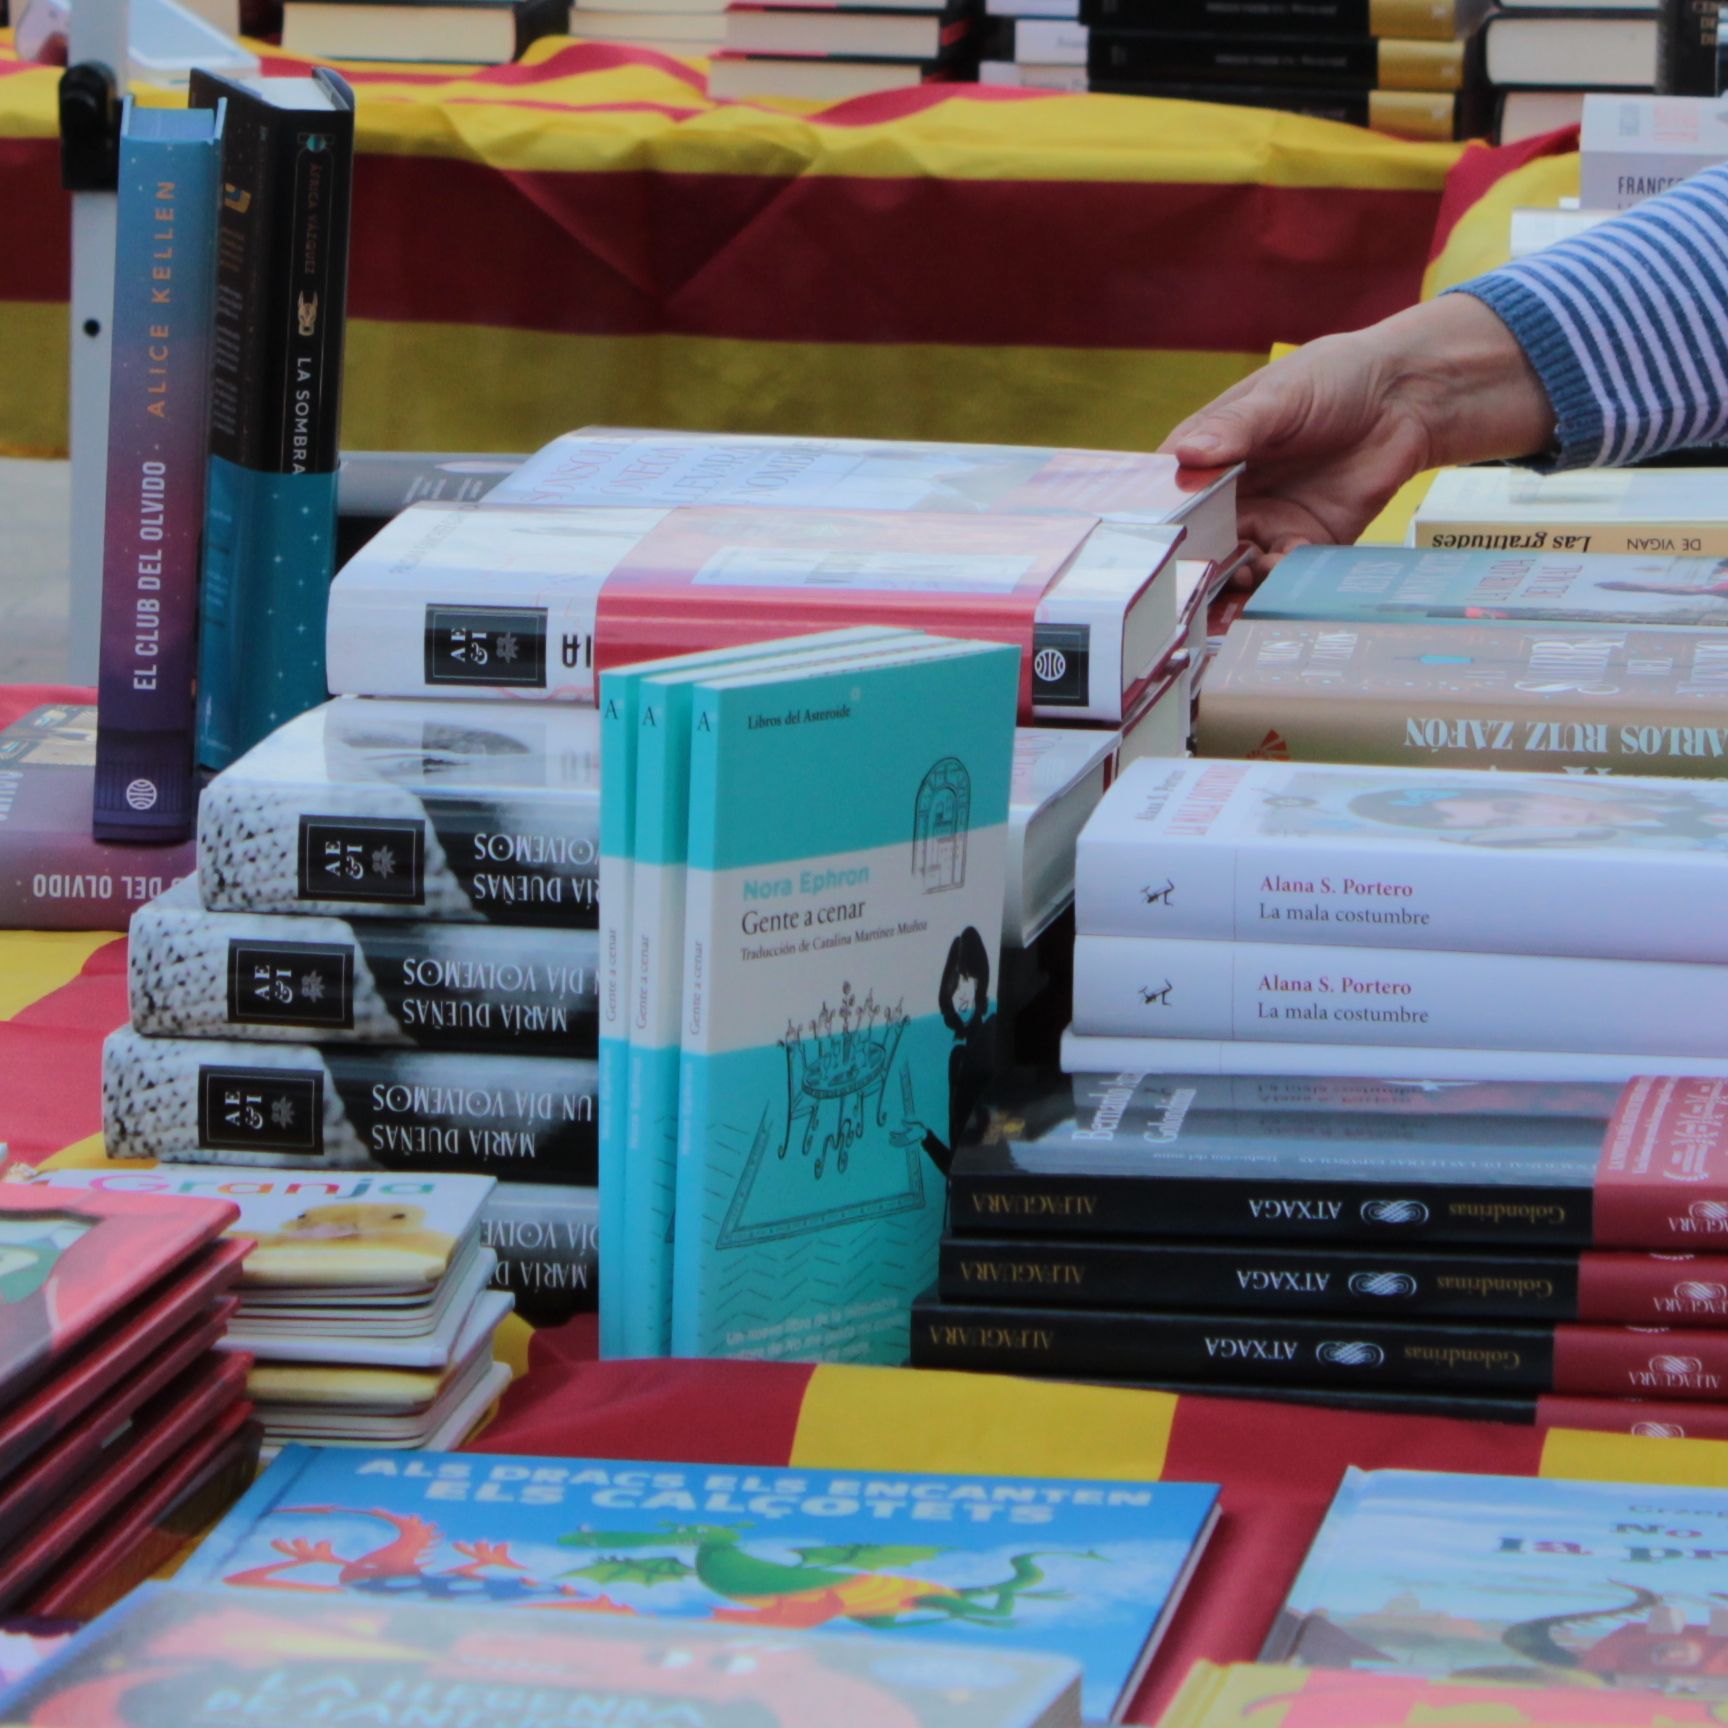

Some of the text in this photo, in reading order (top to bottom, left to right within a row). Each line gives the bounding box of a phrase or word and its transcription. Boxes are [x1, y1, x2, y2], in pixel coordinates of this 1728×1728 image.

[292, 356, 311, 475] LA SOMBRA
[133, 181, 176, 691] EL CLUB DEL OLVIDO ALICE KELLEN
[1431, 530, 1593, 554] Las gratitudes
[1626, 535, 1702, 553] DE VIGAN
[604, 699, 619, 720] A
[642, 706, 658, 726] A
[696, 712, 712, 732] A
[748, 704, 851, 731] Libros del Asteroide
[1404, 717, 1514, 754] ZAFÓN
[1524, 720, 1609, 755] RUIZ
[32, 873, 112, 899] OLVIDO
[121, 875, 164, 900] DEL
[473, 873, 562, 905] DUEÑAS
[742, 864, 870, 901] Nora Ephron
[1259, 875, 1414, 899] Alana S. Portero
[741, 901, 867, 936] Gente a cenar
[1258, 902, 1431, 927] La mala costumbre
[608, 927, 618, 966] cenar
[741, 941, 796, 962] Traducción
[798, 939, 810, 954] de
[812, 933, 852, 951] Catalina
[403, 957, 584, 995] DÍA VOLVEMOS
[636, 933, 650, 1030] Gente cenar
[1257, 974, 1413, 997] Alana S. Portero
[403, 998, 568, 1033] MARÍA DUEÑAS
[606, 979, 617, 1023] Gente
[1257, 1001, 1430, 1026] La mala costumbre
[373, 1083, 593, 1122] UN DÍA VOLVEMOS
[372, 1124, 536, 1159] MARÍA DUEÑAS
[88, 1168, 437, 1201] Granja
[972, 1193, 1098, 1217] ALFAGUARA
[1248, 1198, 1566, 1224] ATXAGA Golondrinas
[480, 1218, 555, 1252] VOLVE
[520, 1261, 589, 1290] MARÍA
[960, 1260, 1086, 1285] ALFAGUARA
[1235, 1269, 1554, 1298] ATXAGA Golondrinas
[1203, 1336, 1521, 1370] ATXAGA Golondrinas
[353, 1457, 1154, 1507] ALS DRACS ELS ENCANTEN
[423, 1479, 1057, 1526] ELS CALÇOTETS
